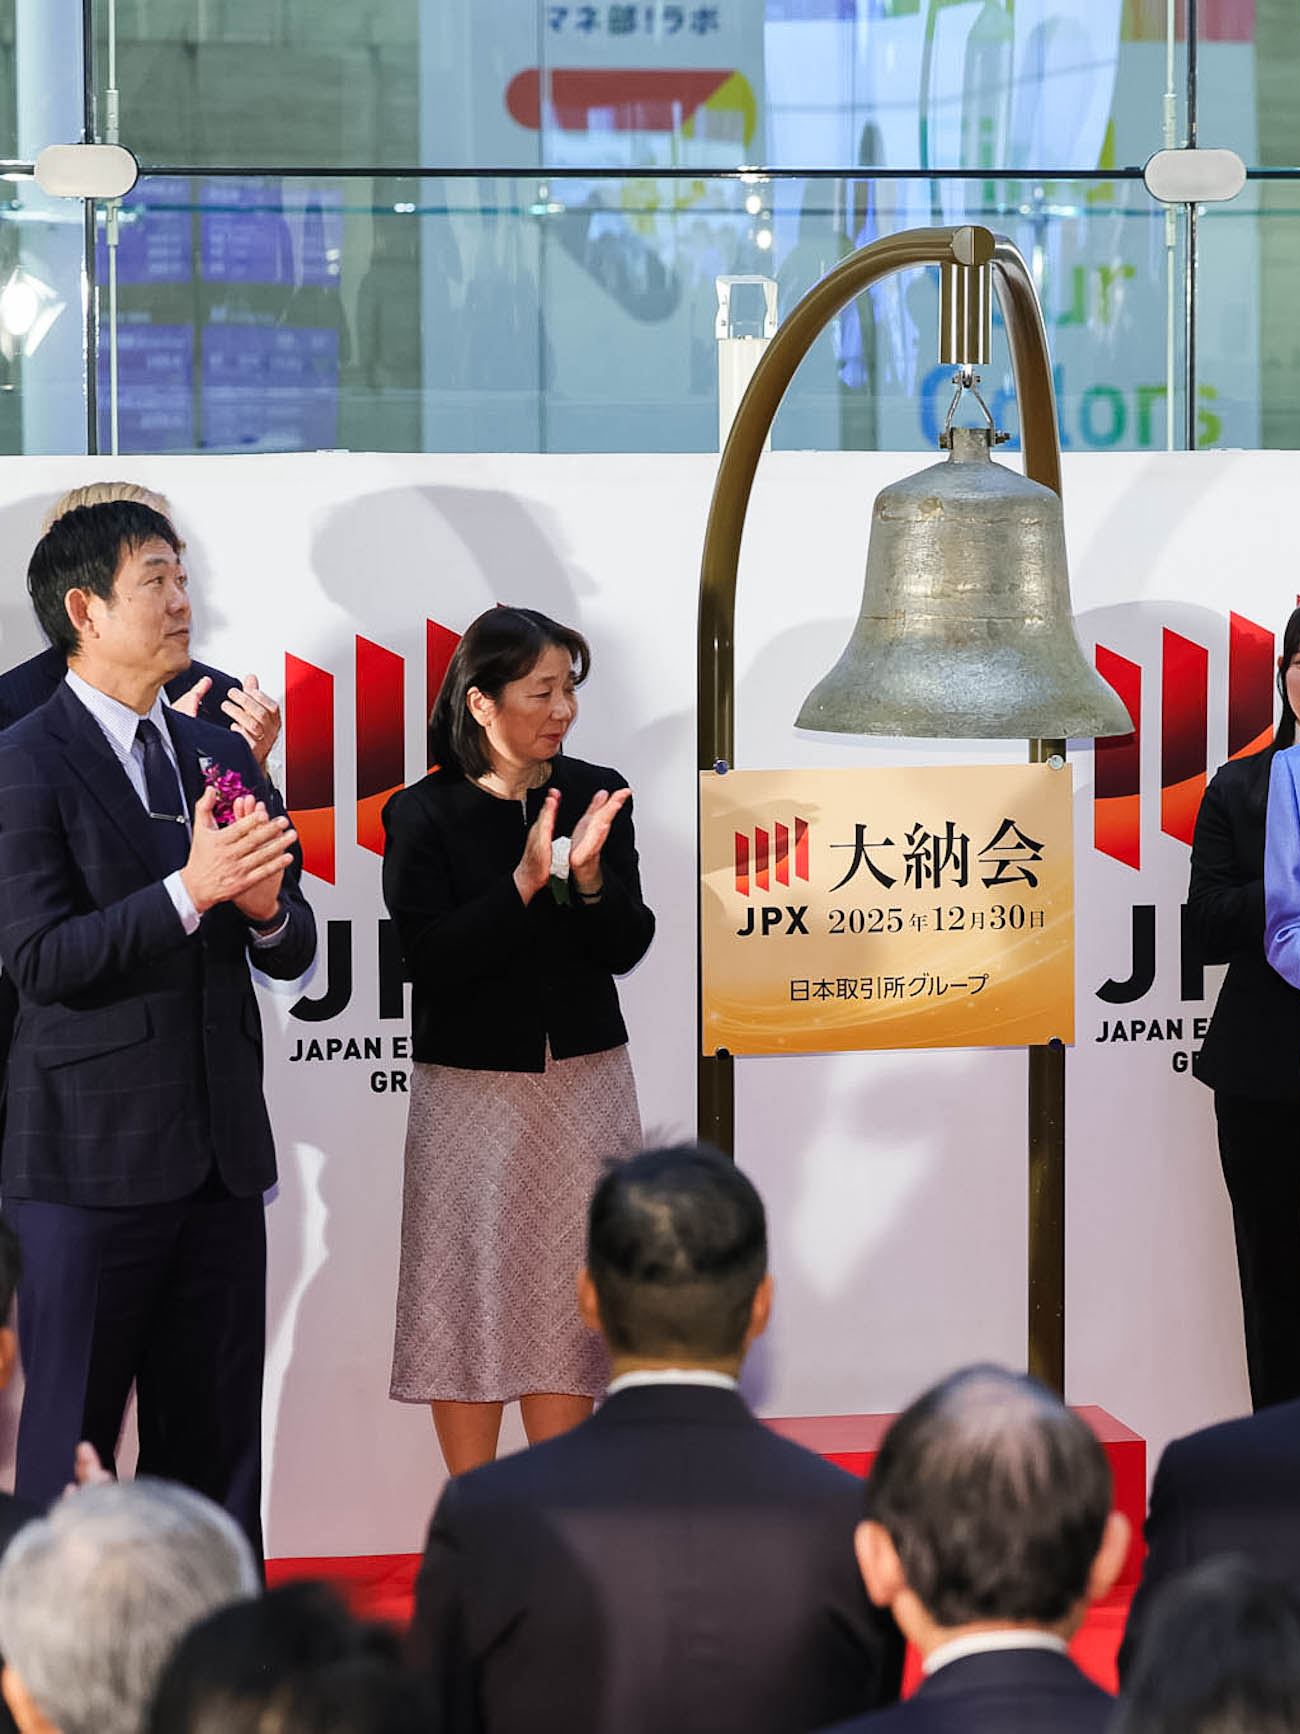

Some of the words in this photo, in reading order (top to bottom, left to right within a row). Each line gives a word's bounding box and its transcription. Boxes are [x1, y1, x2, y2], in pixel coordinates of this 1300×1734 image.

[828, 817, 1046, 893] 大納会
[736, 905, 810, 937] JPX
[828, 903, 1046, 935] 2025年12月30日
[790, 972, 990, 1002] 日本取引所グループ
[1095, 1018, 1183, 1043] JAPAN
[289, 1037, 381, 1061] JAPAN
